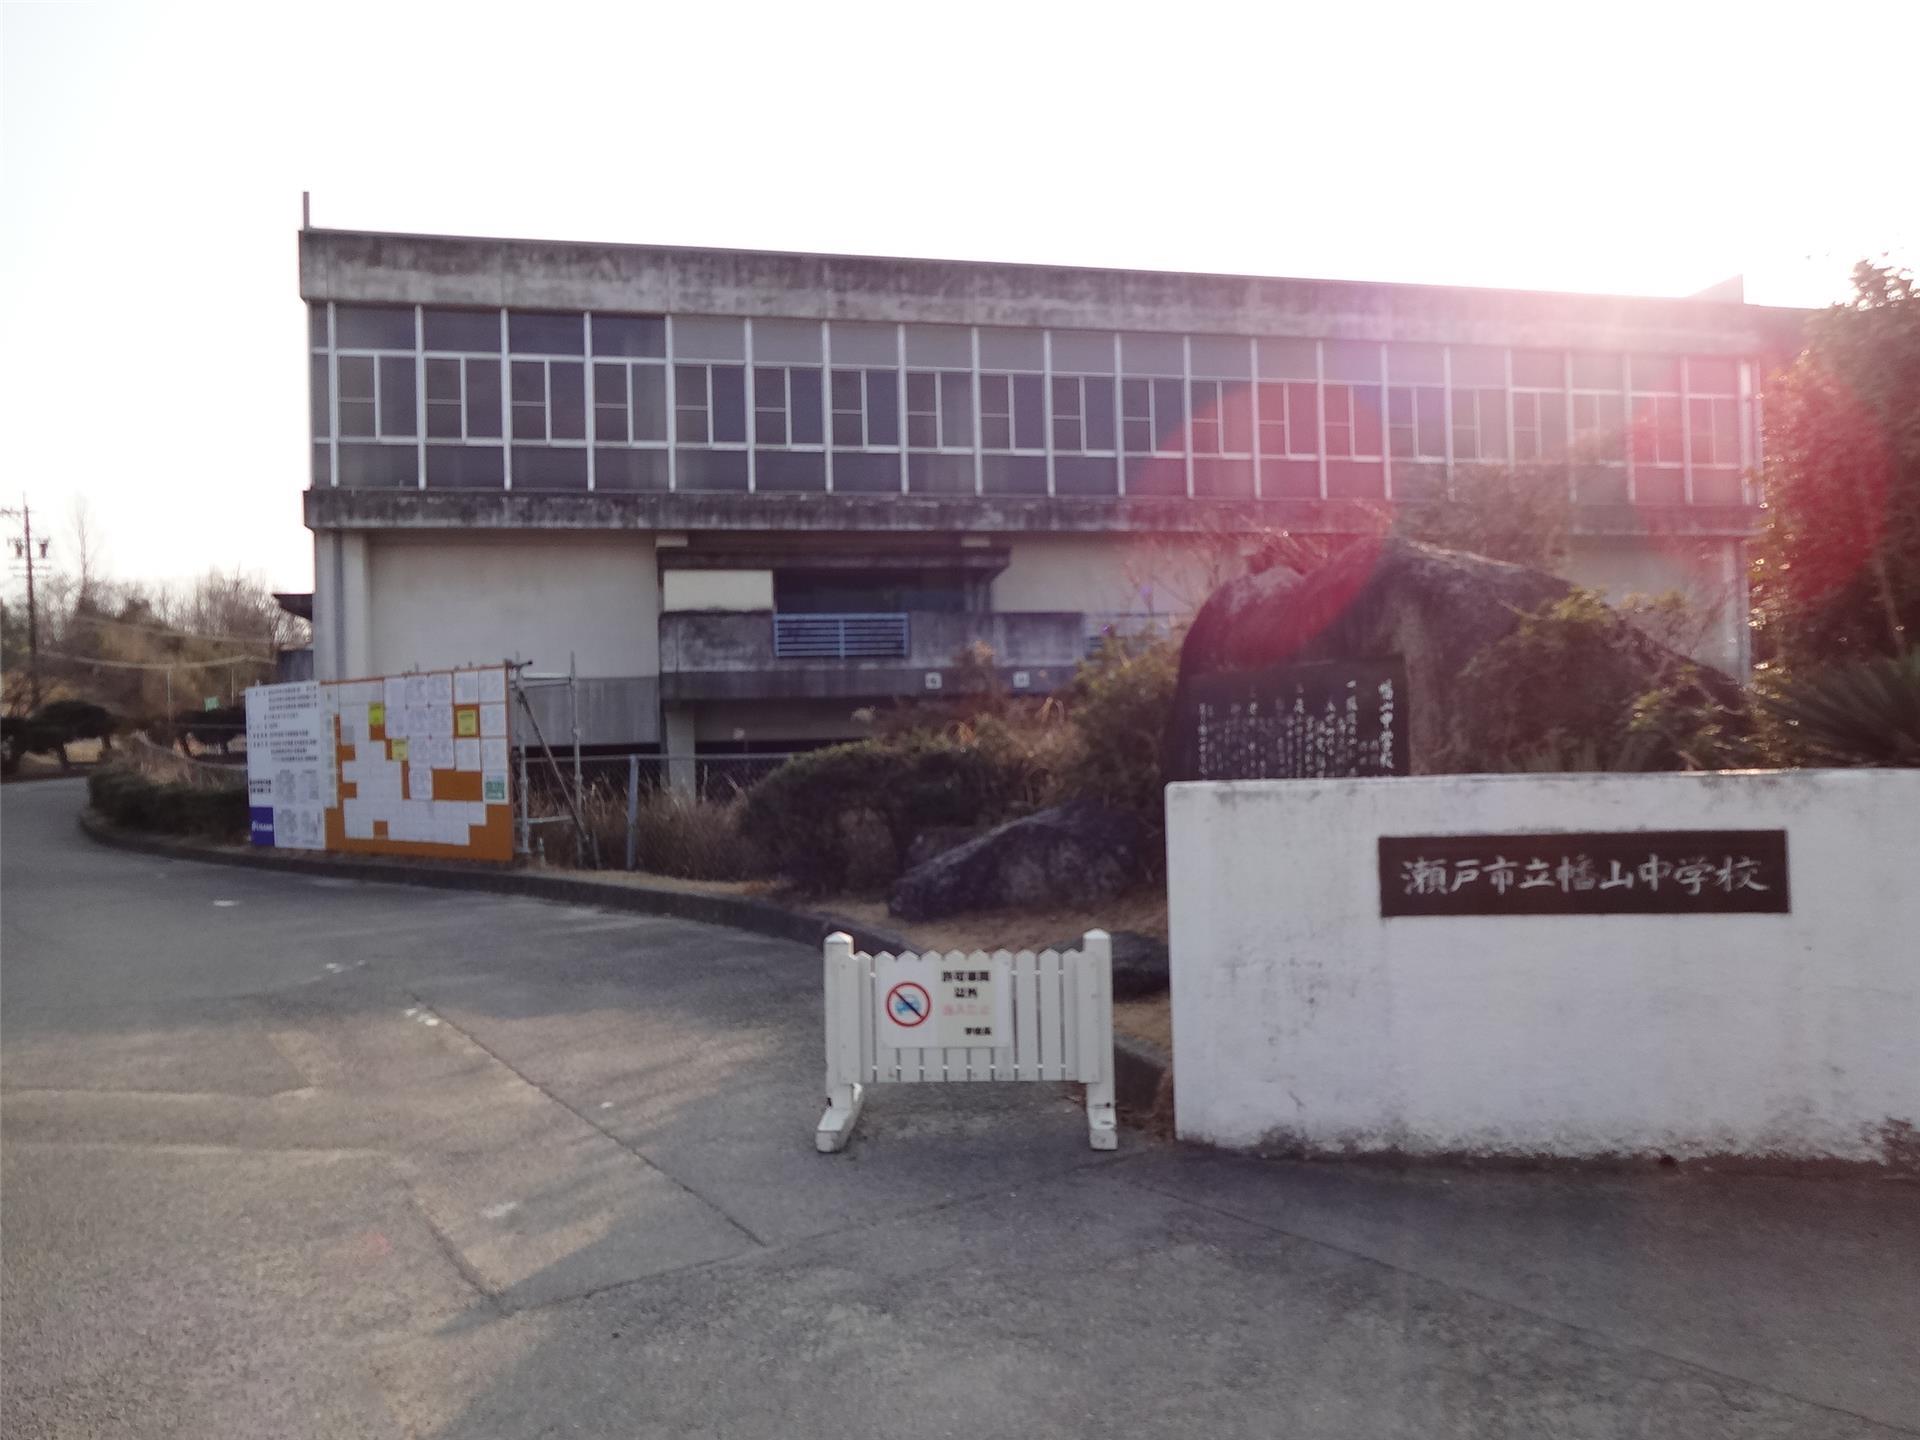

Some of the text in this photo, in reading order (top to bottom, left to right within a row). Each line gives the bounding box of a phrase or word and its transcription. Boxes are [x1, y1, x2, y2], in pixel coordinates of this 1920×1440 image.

[1400, 854, 1770, 895] 瀬戸市立幡山中学校
